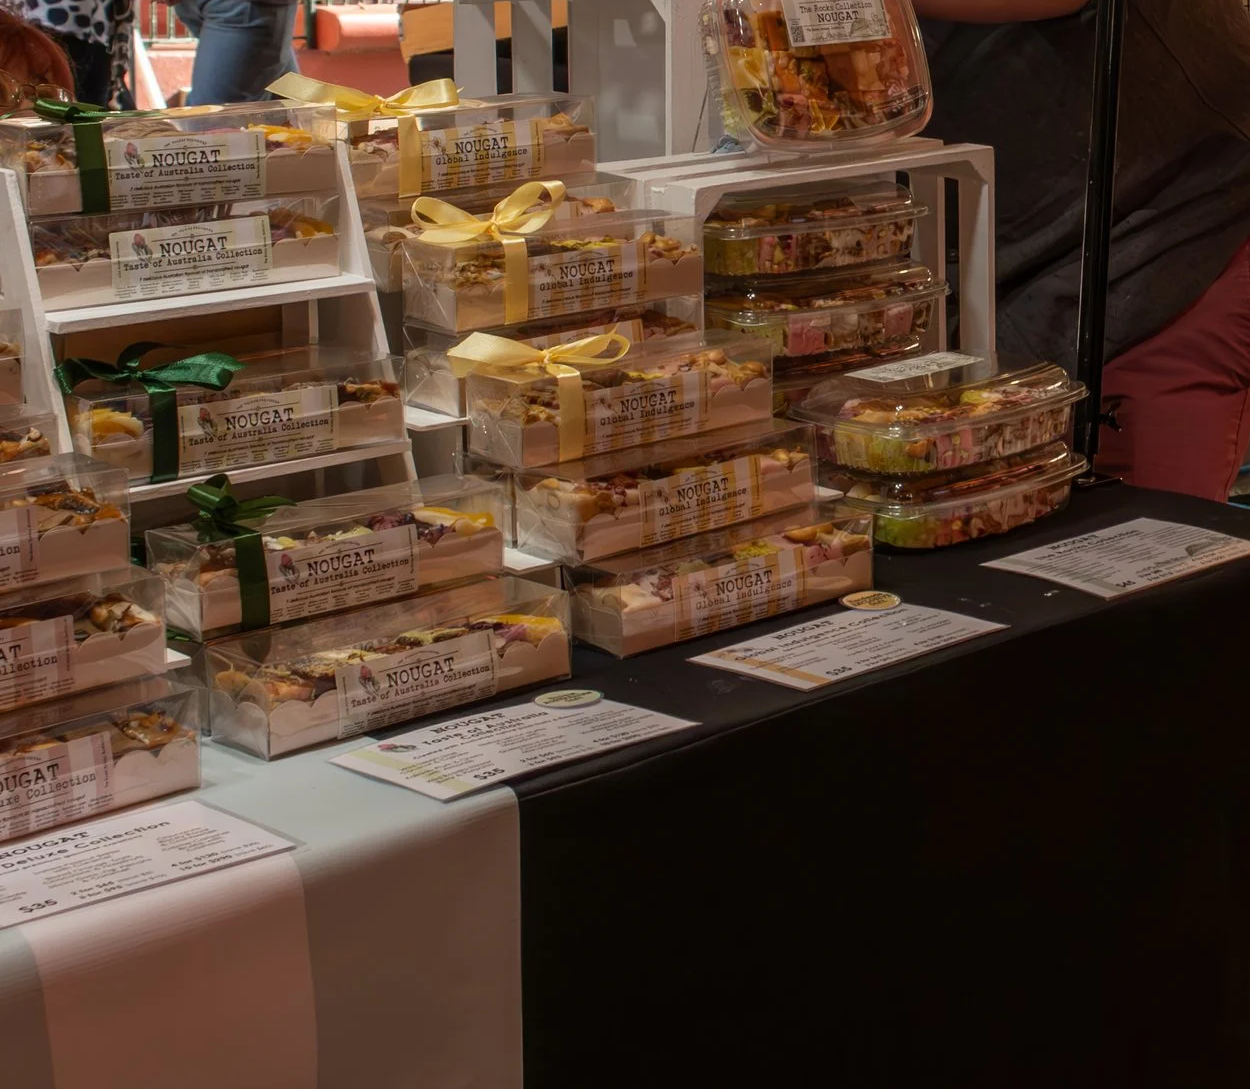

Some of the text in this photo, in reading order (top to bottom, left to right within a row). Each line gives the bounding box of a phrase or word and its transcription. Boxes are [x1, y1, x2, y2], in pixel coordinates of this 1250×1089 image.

[816, 10, 860, 23] NOUGAT
[435, 148, 528, 166] Global Indulgence
[455, 136, 509, 155] NOUGAT
[151, 149, 221, 168] NOUGAT
[115, 163, 256, 181] Taste of Australia Collection
[159, 236, 228, 258] NOUGAT
[123, 248, 263, 272] Taste of Australia Collection
[560, 259, 615, 279] NOUGAT
[540, 270, 634, 291] Global Indulgence
[600, 400, 695, 426] Global Indulgence
[620, 390, 677, 413] NOUGAT
[225, 407, 295, 431] NOUGAT
[188, 437, 214, 447] Taste
[217, 433, 228, 442] of
[231, 427, 278, 440] Australia
[281, 418, 329, 432] Collection
[659, 501, 691, 517] Global
[696, 487, 747, 507] Indulgence
[676, 477, 729, 503] NOUGAT
[307, 548, 375, 577] NOUGAT
[270, 583, 296, 595] Taste
[313, 570, 359, 585] Australia
[362, 558, 409, 575] Collection
[715, 569, 773, 597] NOUGAT
[695, 596, 731, 611] Global
[736, 579, 792, 600] Indulgence
[0, 655, 58, 675] llection
[386, 656, 455, 688] NOUGAT
[351, 695, 377, 708] Taste
[380, 690, 390, 700] of
[394, 679, 440, 697] Australia
[443, 665, 490, 683] Collection
[430, 711, 506, 735] NOUGAT
[0, 763, 59, 794] UGAT
[26, 772, 97, 800] Collection
[473, 768, 505, 781] $35
[1, 848, 69, 869] Deluxe
[74, 821, 171, 849] Collection
[18, 898, 58, 914] $35
